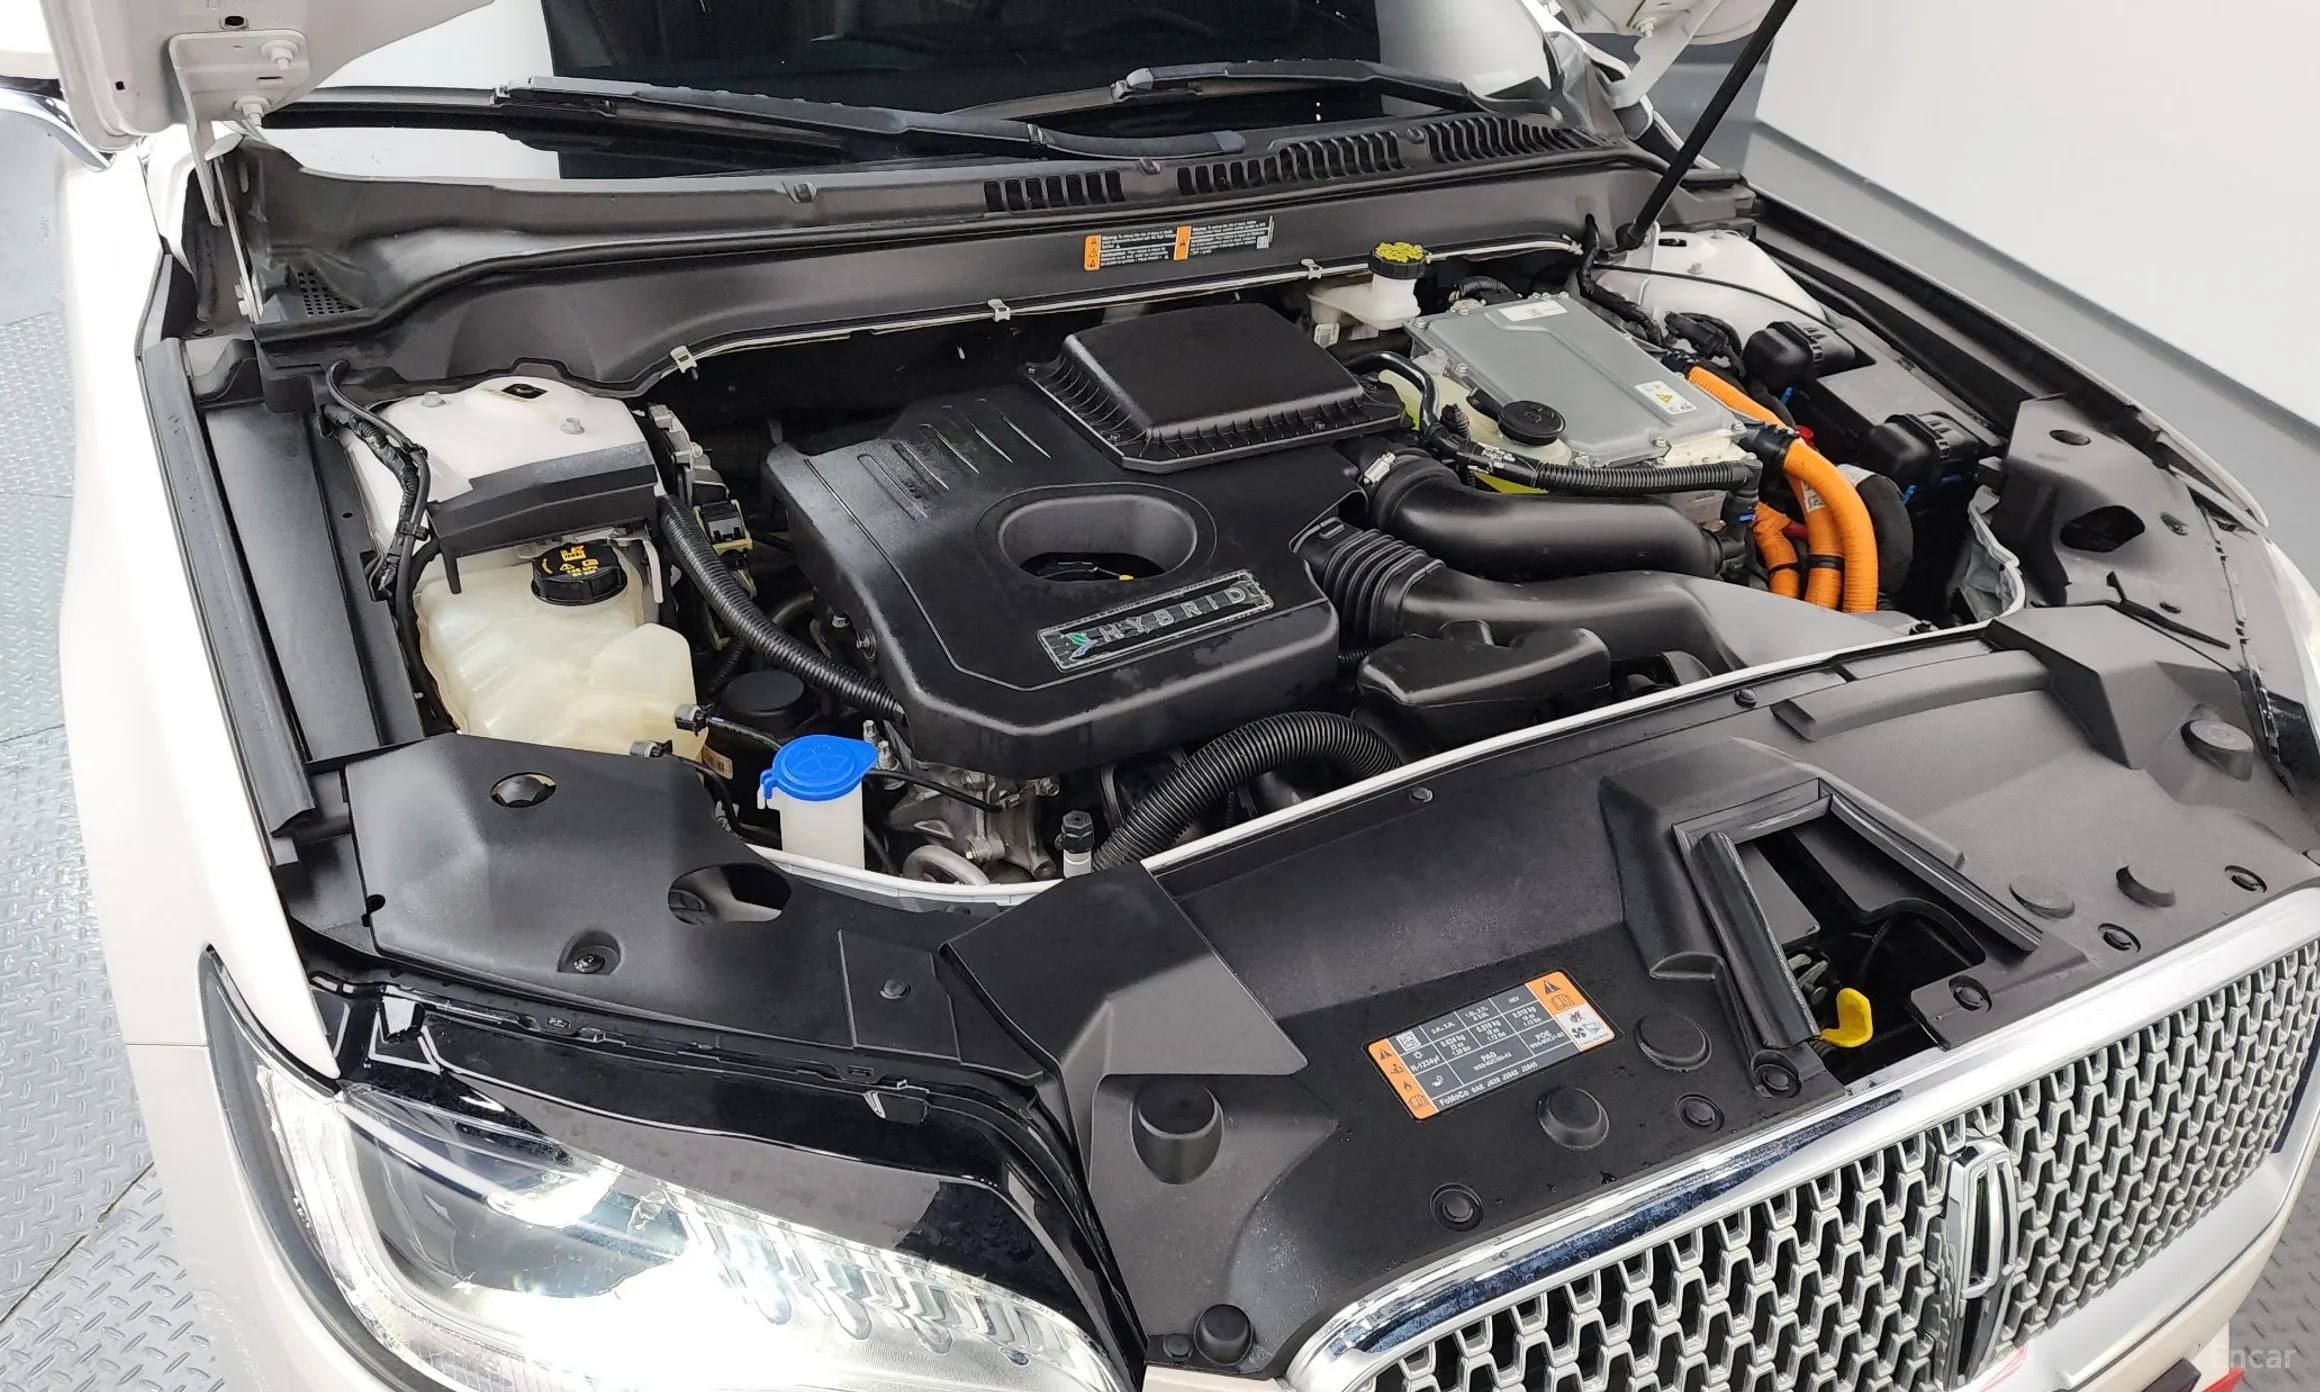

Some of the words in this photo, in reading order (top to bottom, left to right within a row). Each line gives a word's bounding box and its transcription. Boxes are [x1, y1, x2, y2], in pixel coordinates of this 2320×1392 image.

[1100, 586, 1246, 643] HYBRID
[1535, 1030, 1552, 1041] POE
[1410, 1055, 1440, 1071] R-1234yf
[1480, 1052, 1496, 1061] PAG
[1439, 1090, 1469, 1106] FoMoCo
